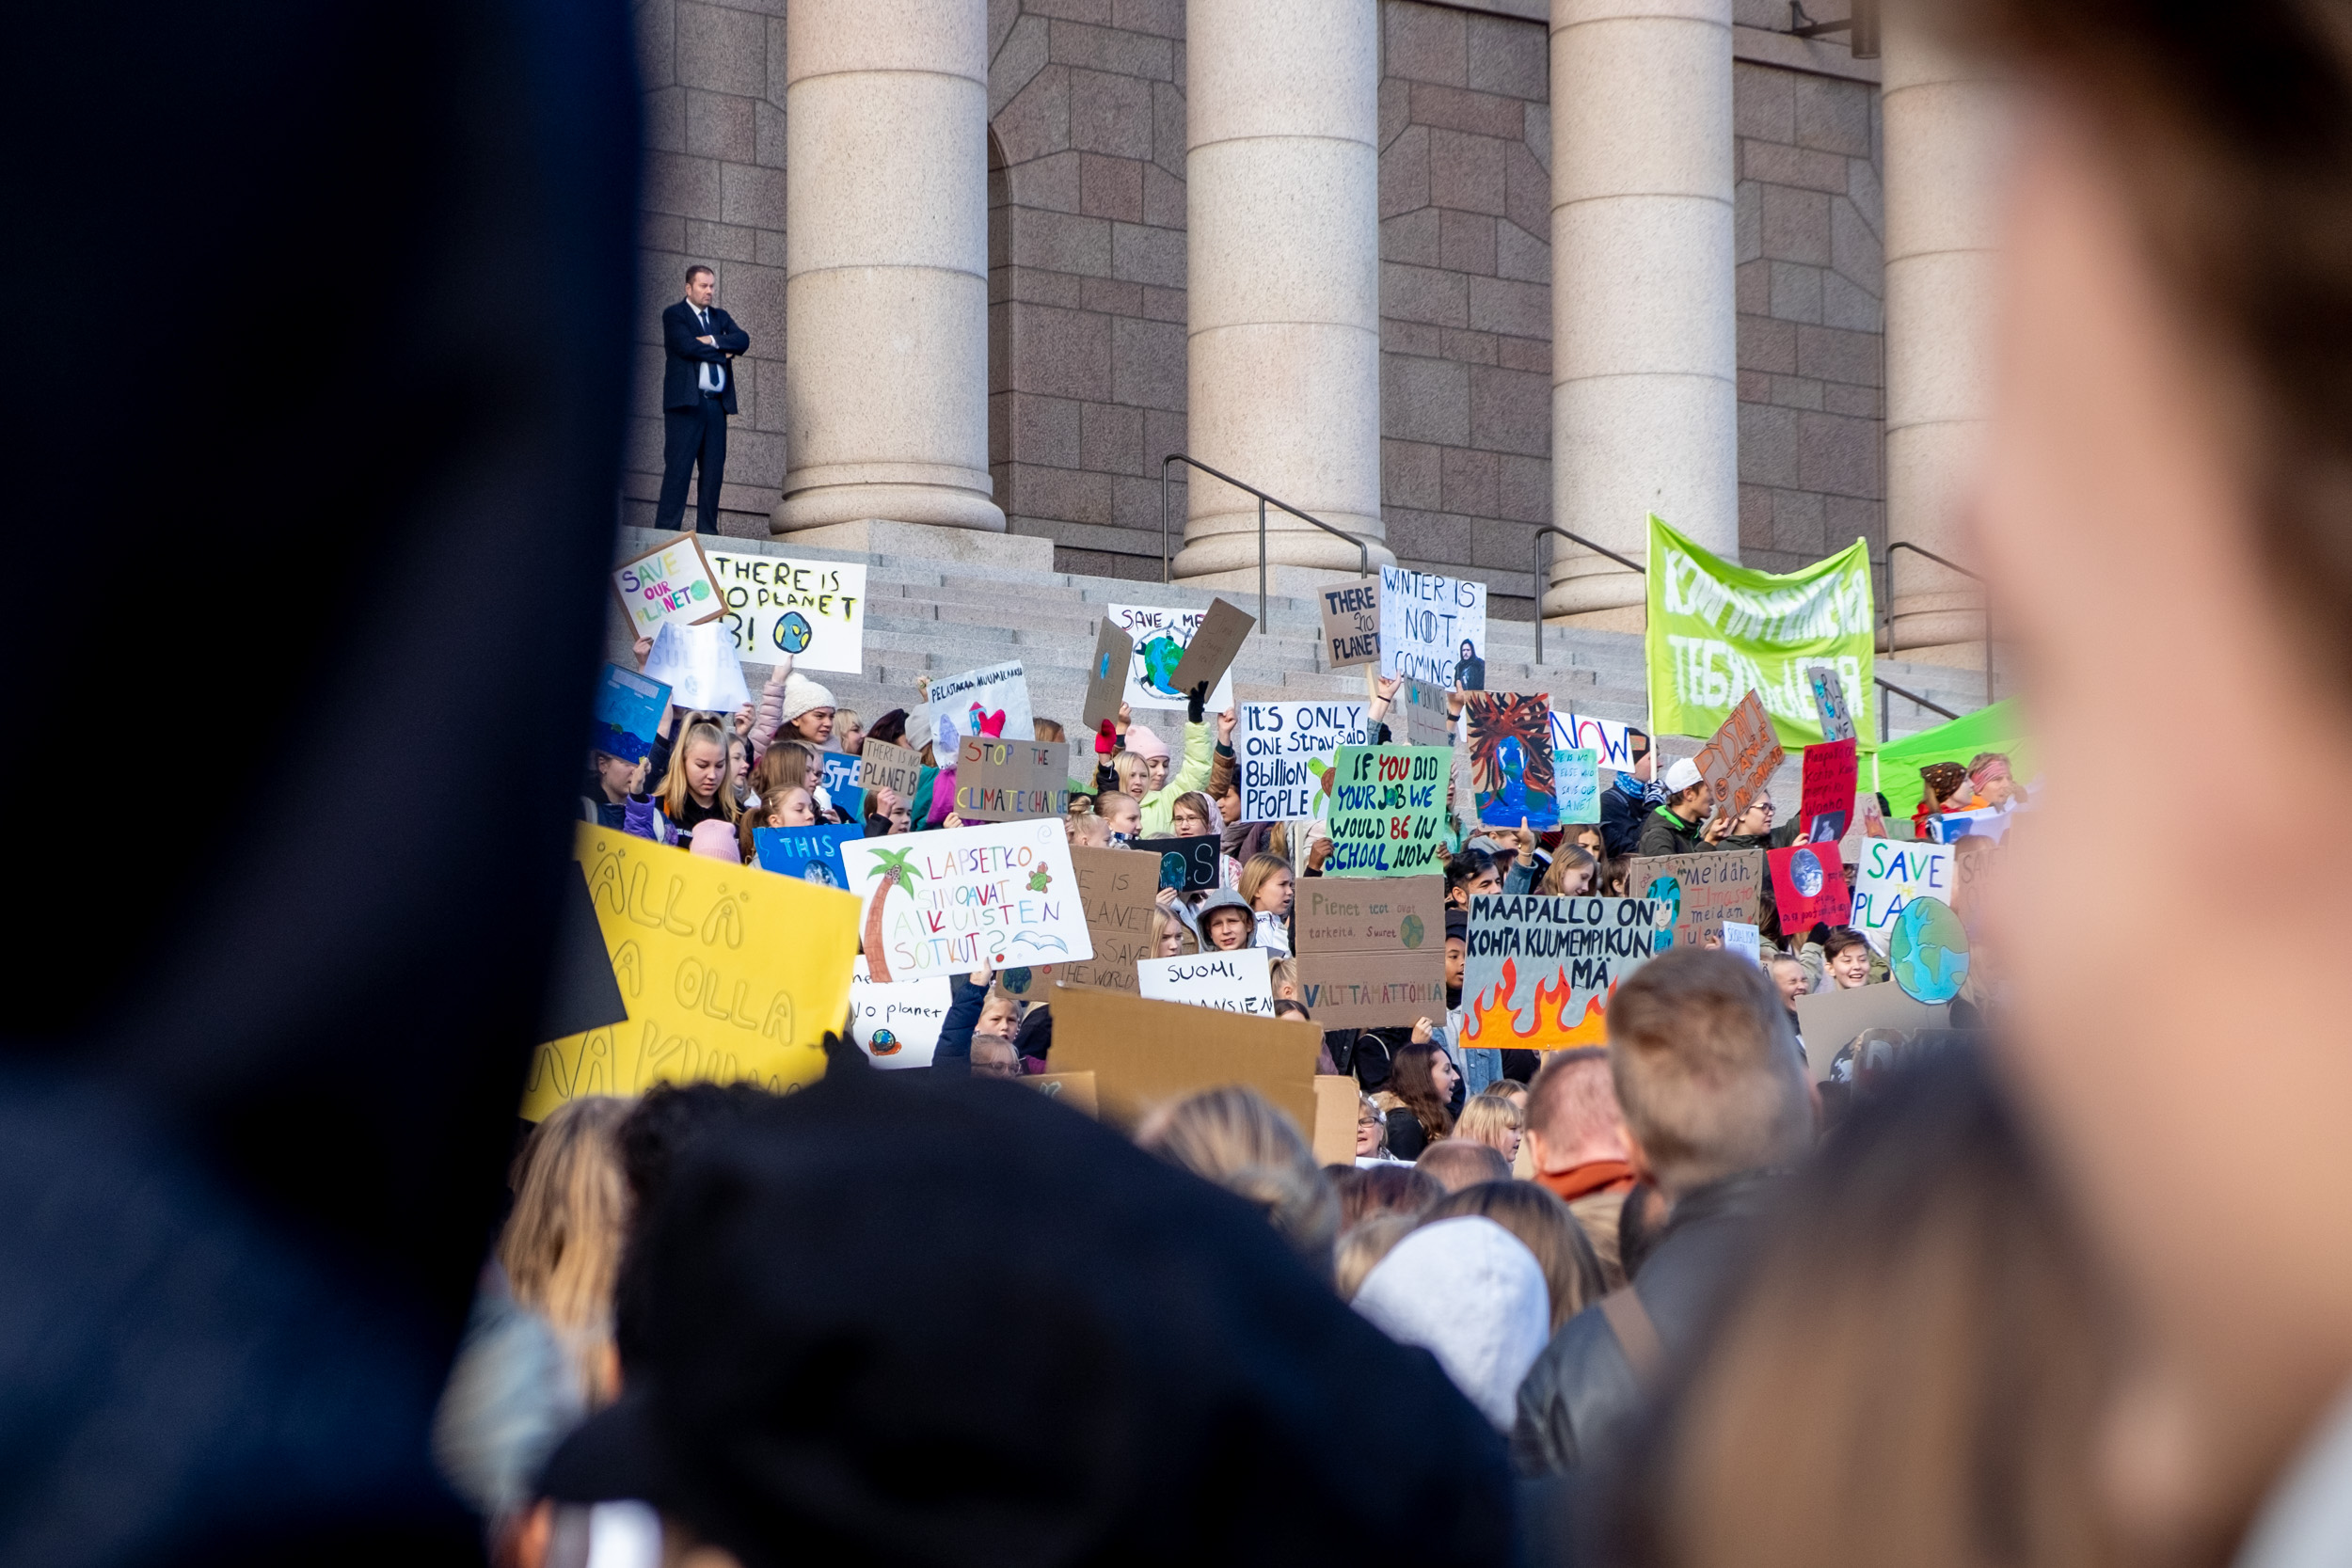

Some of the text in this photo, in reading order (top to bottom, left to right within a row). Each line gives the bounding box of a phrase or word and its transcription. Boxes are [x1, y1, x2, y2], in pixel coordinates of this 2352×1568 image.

[622, 552, 680, 593] SAVE
[715, 557, 839, 592] THERE IS
[644, 580, 672, 600] OUR
[1326, 586, 1375, 615] THERE
[1383, 567, 1475, 608] WINTER IS
[636, 586, 690, 625] PLANET
[722, 587, 856, 619] O PLANET
[1121, 610, 1162, 631] SAVE
[1405, 608, 1456, 648] NOT
[1394, 650, 1453, 688] COMING
[1296, 706, 1360, 730] ONLY
[1247, 736, 1281, 755] ONE
[1549, 710, 1629, 765] NOW
[866, 740, 919, 768] THERE IS NO
[965, 742, 1048, 765] STOP THE
[1353, 752, 1438, 782] IF YOU DID
[863, 762, 917, 796] PLANET B
[957, 787, 1068, 814] CLIMATE CHANGE
[1247, 789, 1308, 819] PEOPLE
[1338, 784, 1376, 811] YOUR
[1410, 784, 1436, 808] WE
[1330, 815, 1437, 840] WOULD BE IN
[779, 835, 834, 858] THIS
[1326, 842, 1437, 871] SCHOOL NOW
[928, 847, 1032, 879] LAPSETKO
[1867, 843, 1946, 888] SAVE
[918, 879, 1009, 910] SIIVOAVAT
[1112, 873, 1129, 892] IS
[1895, 884, 1915, 897] THE
[895, 900, 1059, 938] AIKUISTEN
[1311, 893, 1360, 916] Pienet
[1369, 903, 1390, 915] teot
[1472, 895, 1655, 927] MAAPALLO ON
[1366, 926, 1397, 938] Suuret
[1468, 927, 1520, 958] KOHTA
[1525, 927, 1603, 958] KUUMEMPI
[1605, 927, 1653, 958] KUN
[1102, 939, 1149, 966] SAVE
[1094, 968, 1135, 990] WORLD
[1571, 957, 1611, 990] MÄ
[675, 956, 795, 1046] OLLA
[887, 1002, 942, 1023] planet
